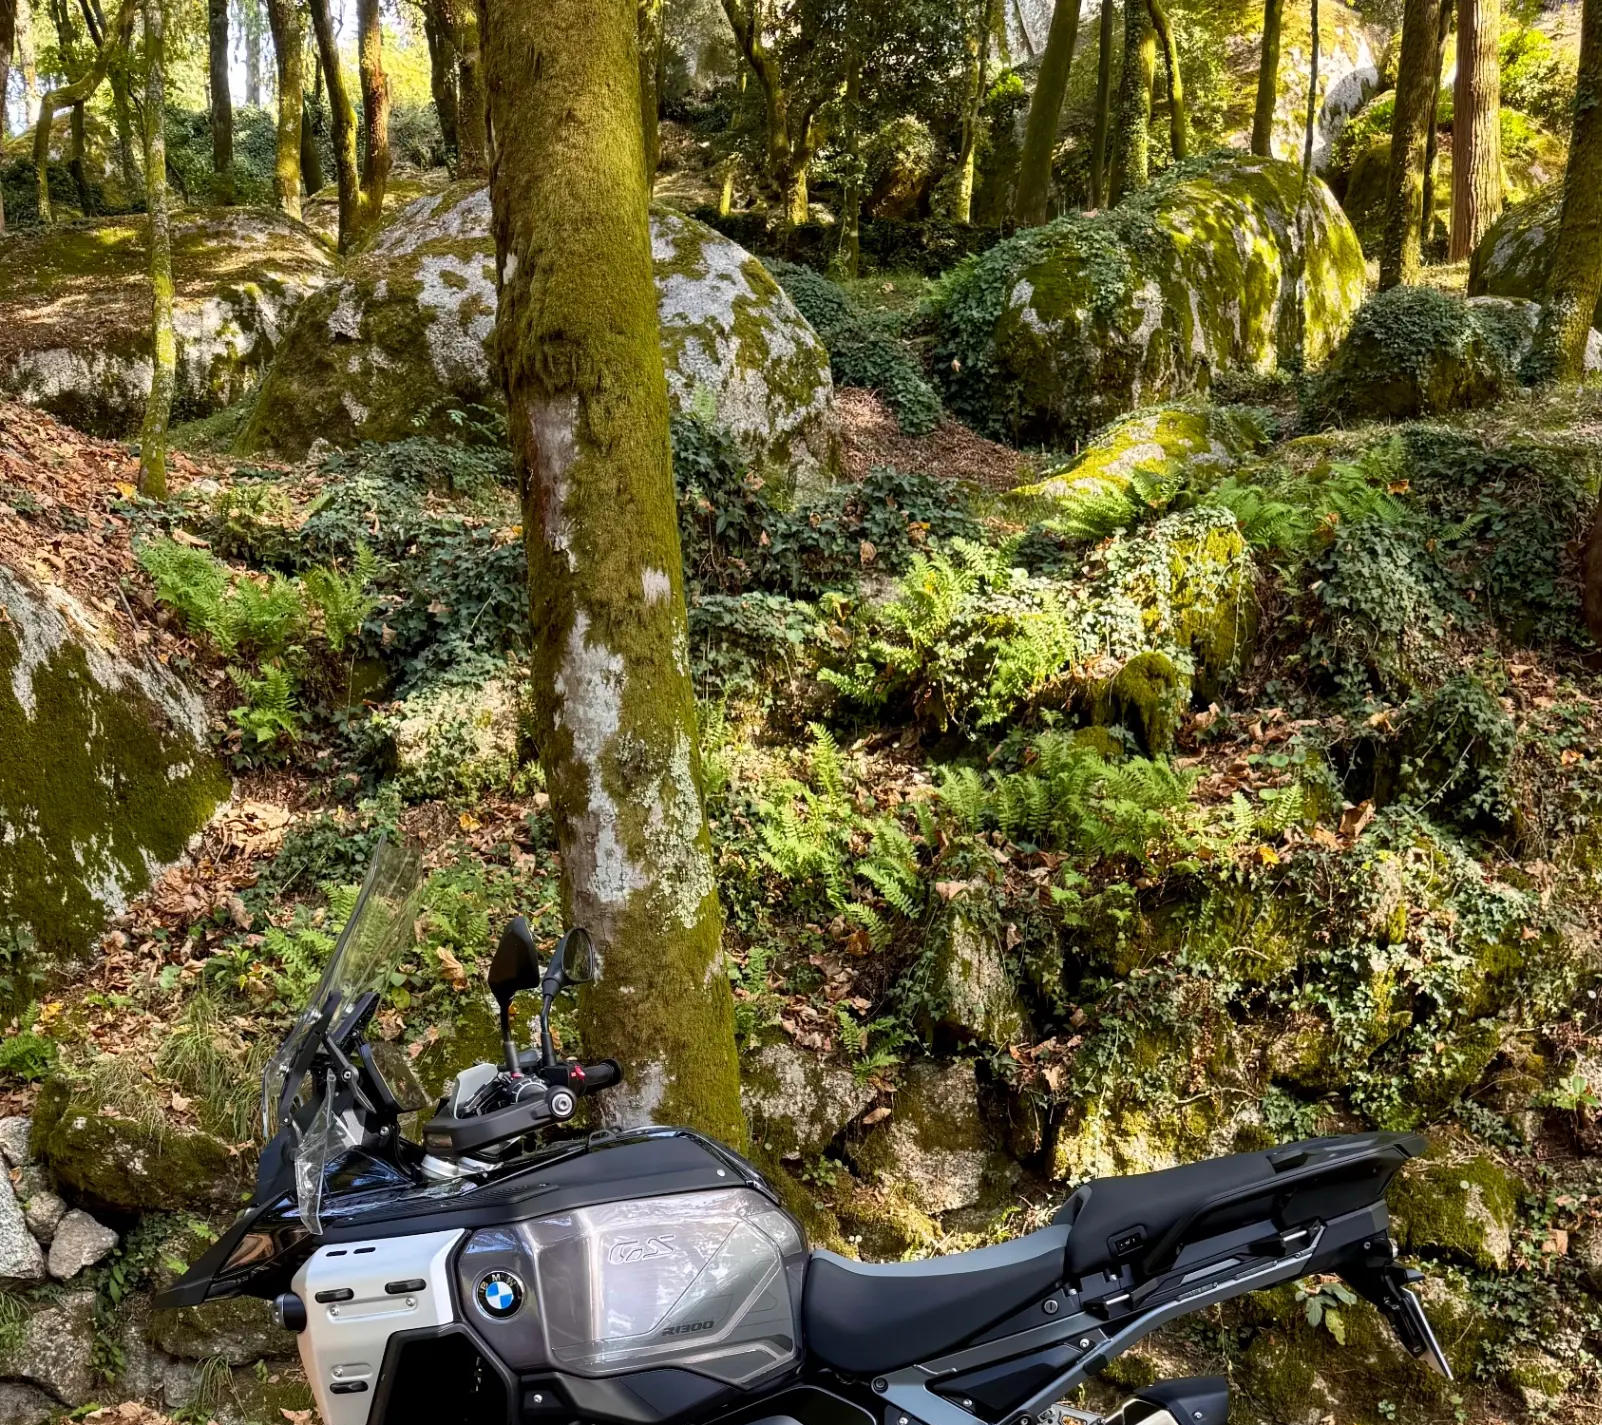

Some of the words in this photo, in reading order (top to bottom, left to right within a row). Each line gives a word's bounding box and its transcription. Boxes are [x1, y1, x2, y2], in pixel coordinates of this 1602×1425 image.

[608, 1234, 676, 1265] GS
[479, 1273, 518, 1292] BMW
[661, 1320, 715, 1337] R1300
